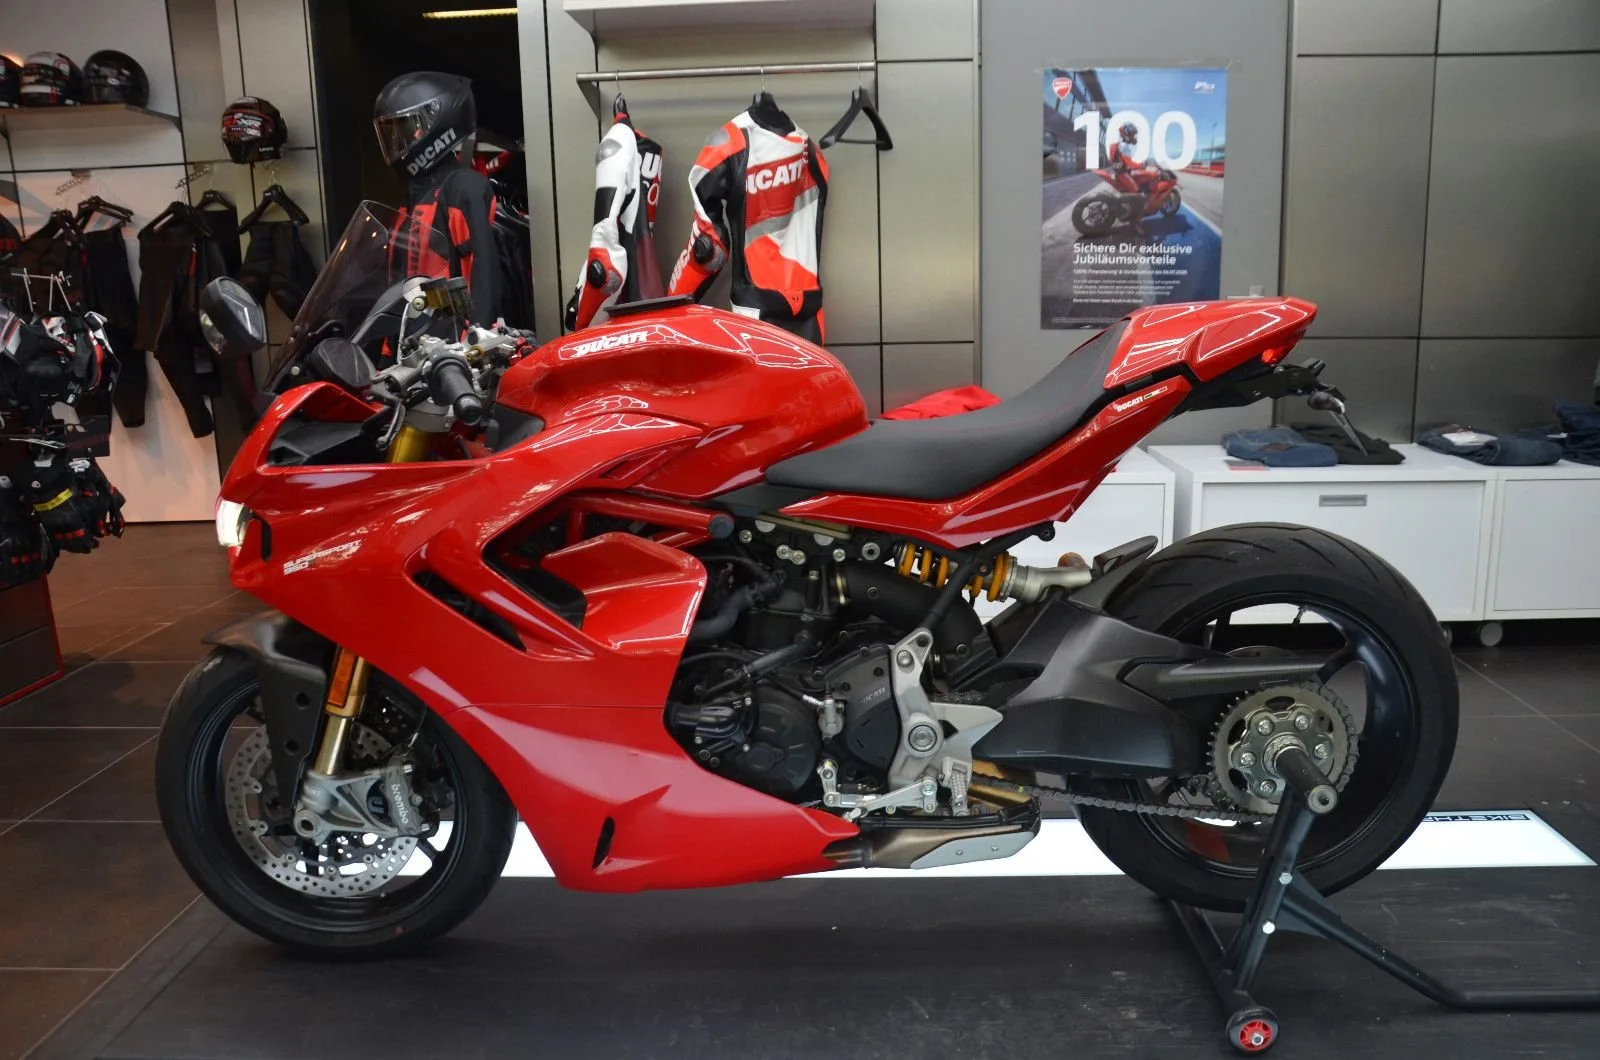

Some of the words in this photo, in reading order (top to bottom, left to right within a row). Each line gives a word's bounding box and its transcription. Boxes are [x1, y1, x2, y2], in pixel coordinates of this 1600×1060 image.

[406, 127, 457, 176] DUCATI
[1073, 110, 1197, 170] 100
[745, 158, 804, 195] UCATI
[1072, 253, 1177, 265] Jubiläumsvorteile
[1073, 242, 1116, 253] Sichere
[1119, 242, 1137, 253] Dir
[1138, 242, 1193, 254] exklusive
[570, 330, 649, 358] DUCATI
[1116, 395, 1144, 412] DUCATI
[391, 783, 409, 825] brembo
